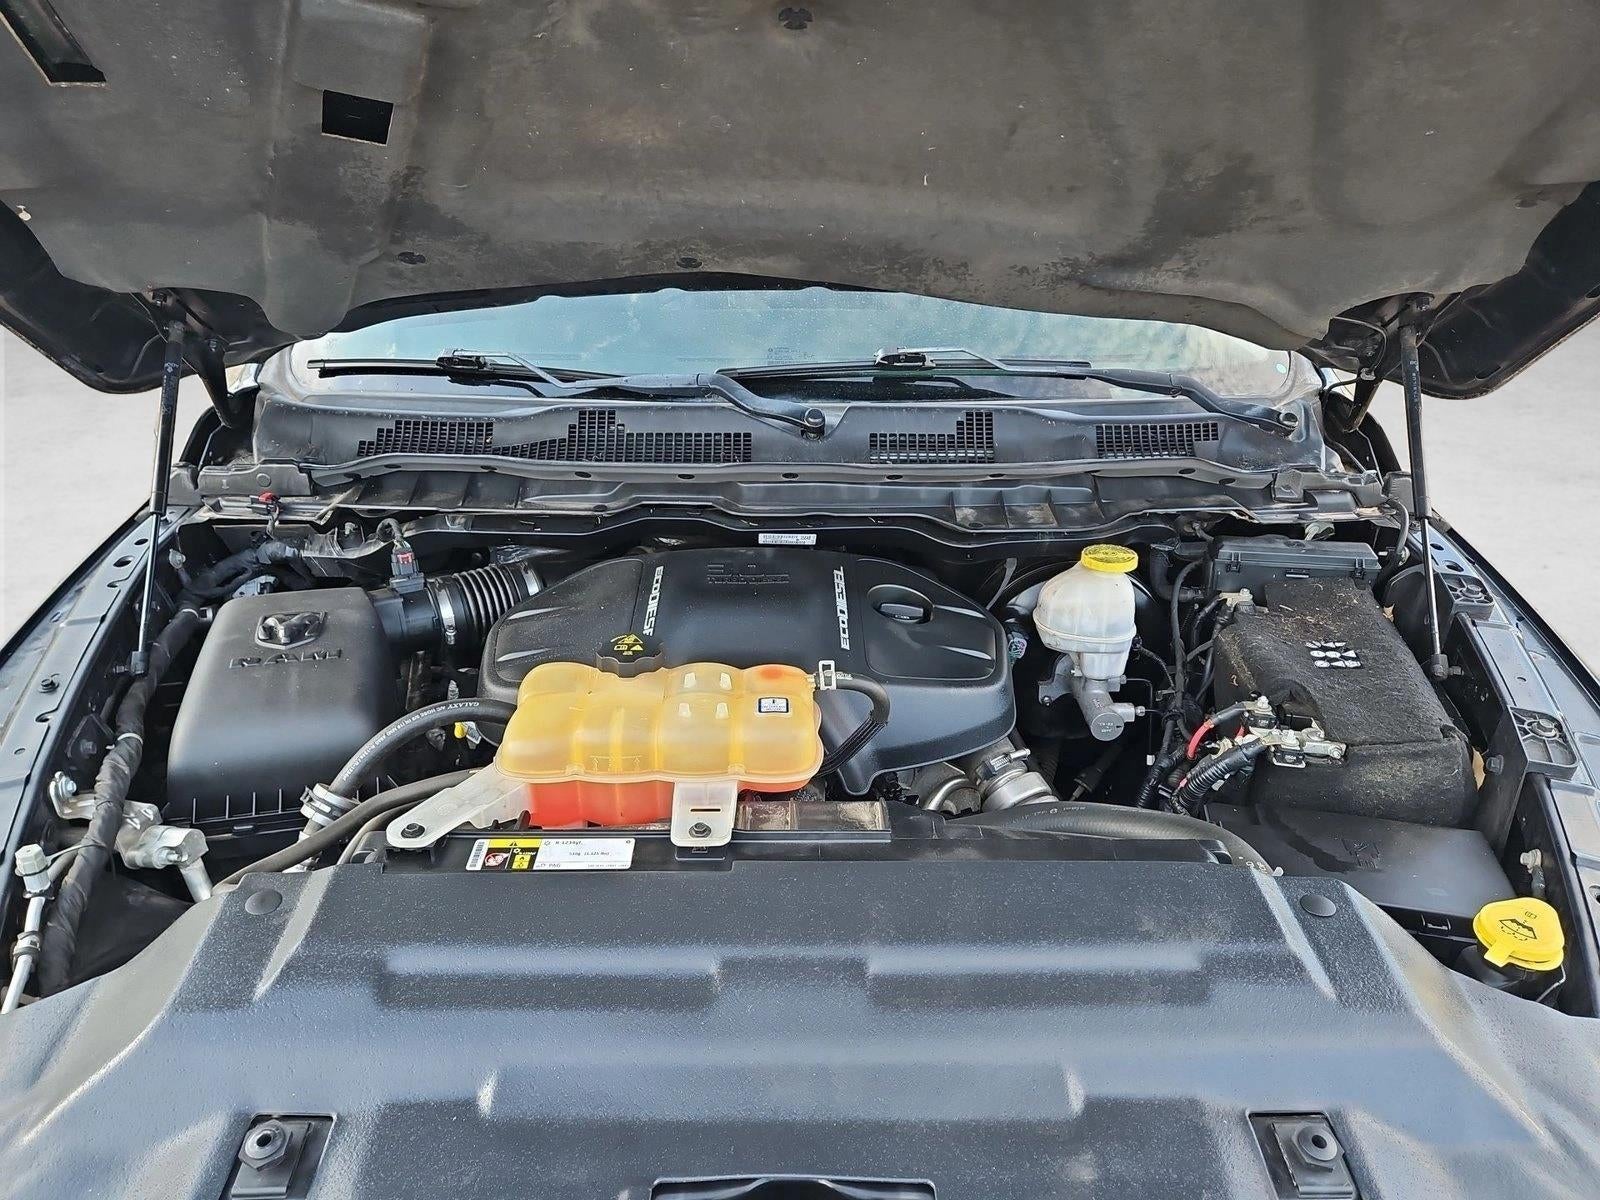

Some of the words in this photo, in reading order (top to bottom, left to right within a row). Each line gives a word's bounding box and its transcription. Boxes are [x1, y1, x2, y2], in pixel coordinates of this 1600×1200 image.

[643, 565, 664, 637] ECODIESE
[833, 565, 850, 651] ECODIESEL
[447, 702, 480, 710] GALAXY
